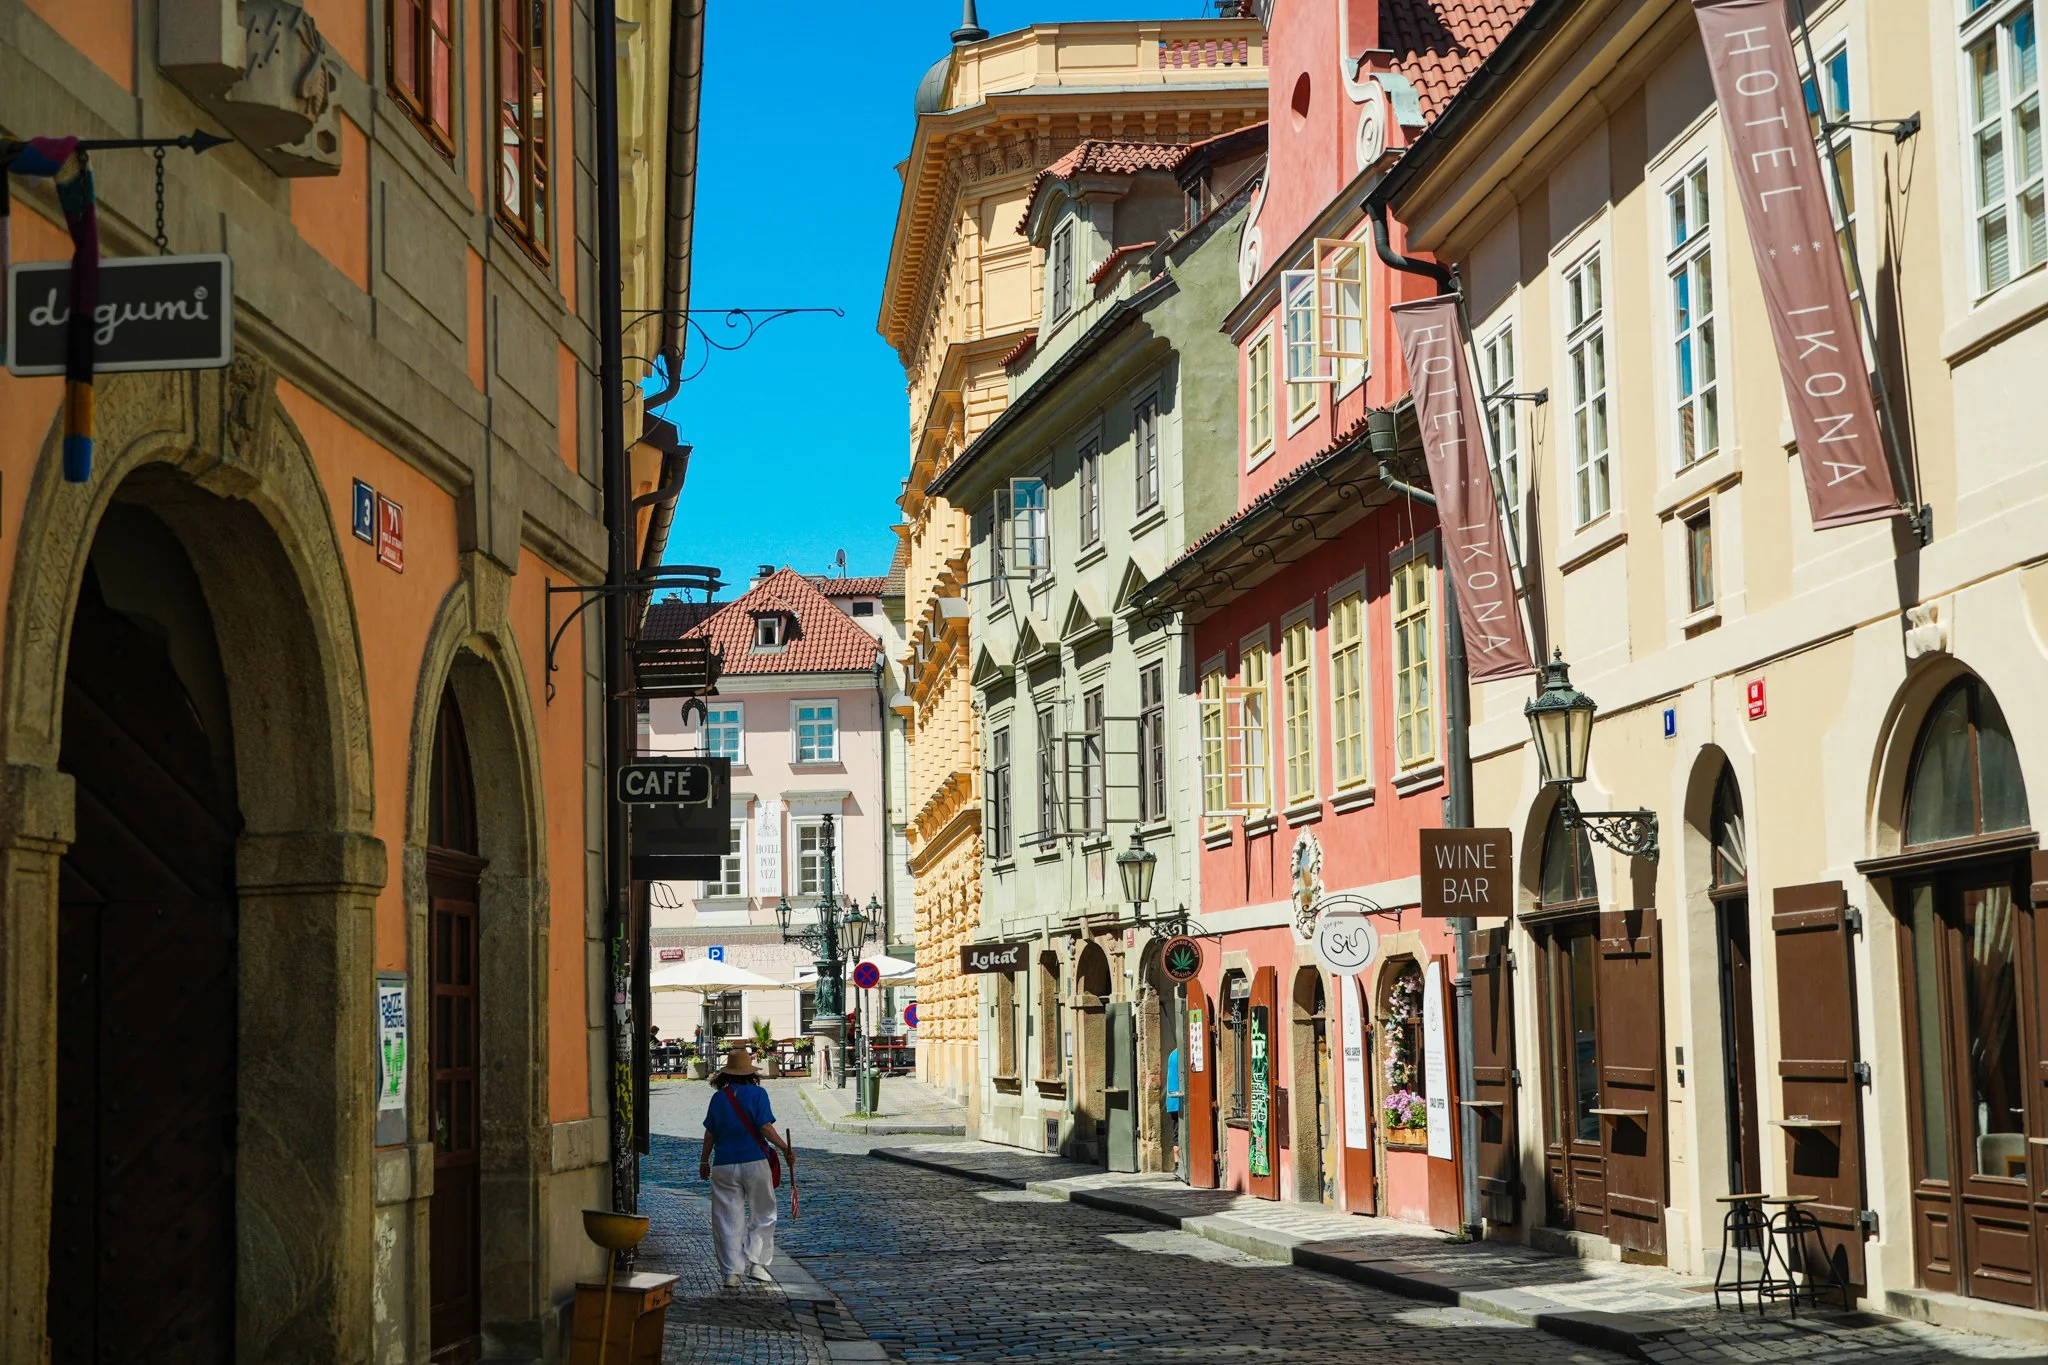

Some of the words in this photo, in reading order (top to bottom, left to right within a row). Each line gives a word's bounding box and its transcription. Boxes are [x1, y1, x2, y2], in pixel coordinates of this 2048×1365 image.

[1724, 26, 1801, 212] HOTEL
[1787, 304, 1866, 487] IKONA
[29, 285, 209, 345] dgumi
[1413, 324, 1466, 458] HOTEL
[1457, 523, 1511, 653] IKONA
[364, 498, 371, 526] 3
[387, 505, 399, 535] 71
[625, 767, 691, 796] CAFÉ
[755, 844, 780, 855] HOTEL
[760, 857, 776, 867] POD
[1434, 843, 1497, 870] WINE
[1443, 877, 1489, 904] BAR
[1166, 940, 1188, 957] CANNABIS
[1188, 942, 1199, 958] POINT
[1171, 968, 1192, 978] PRAHA
